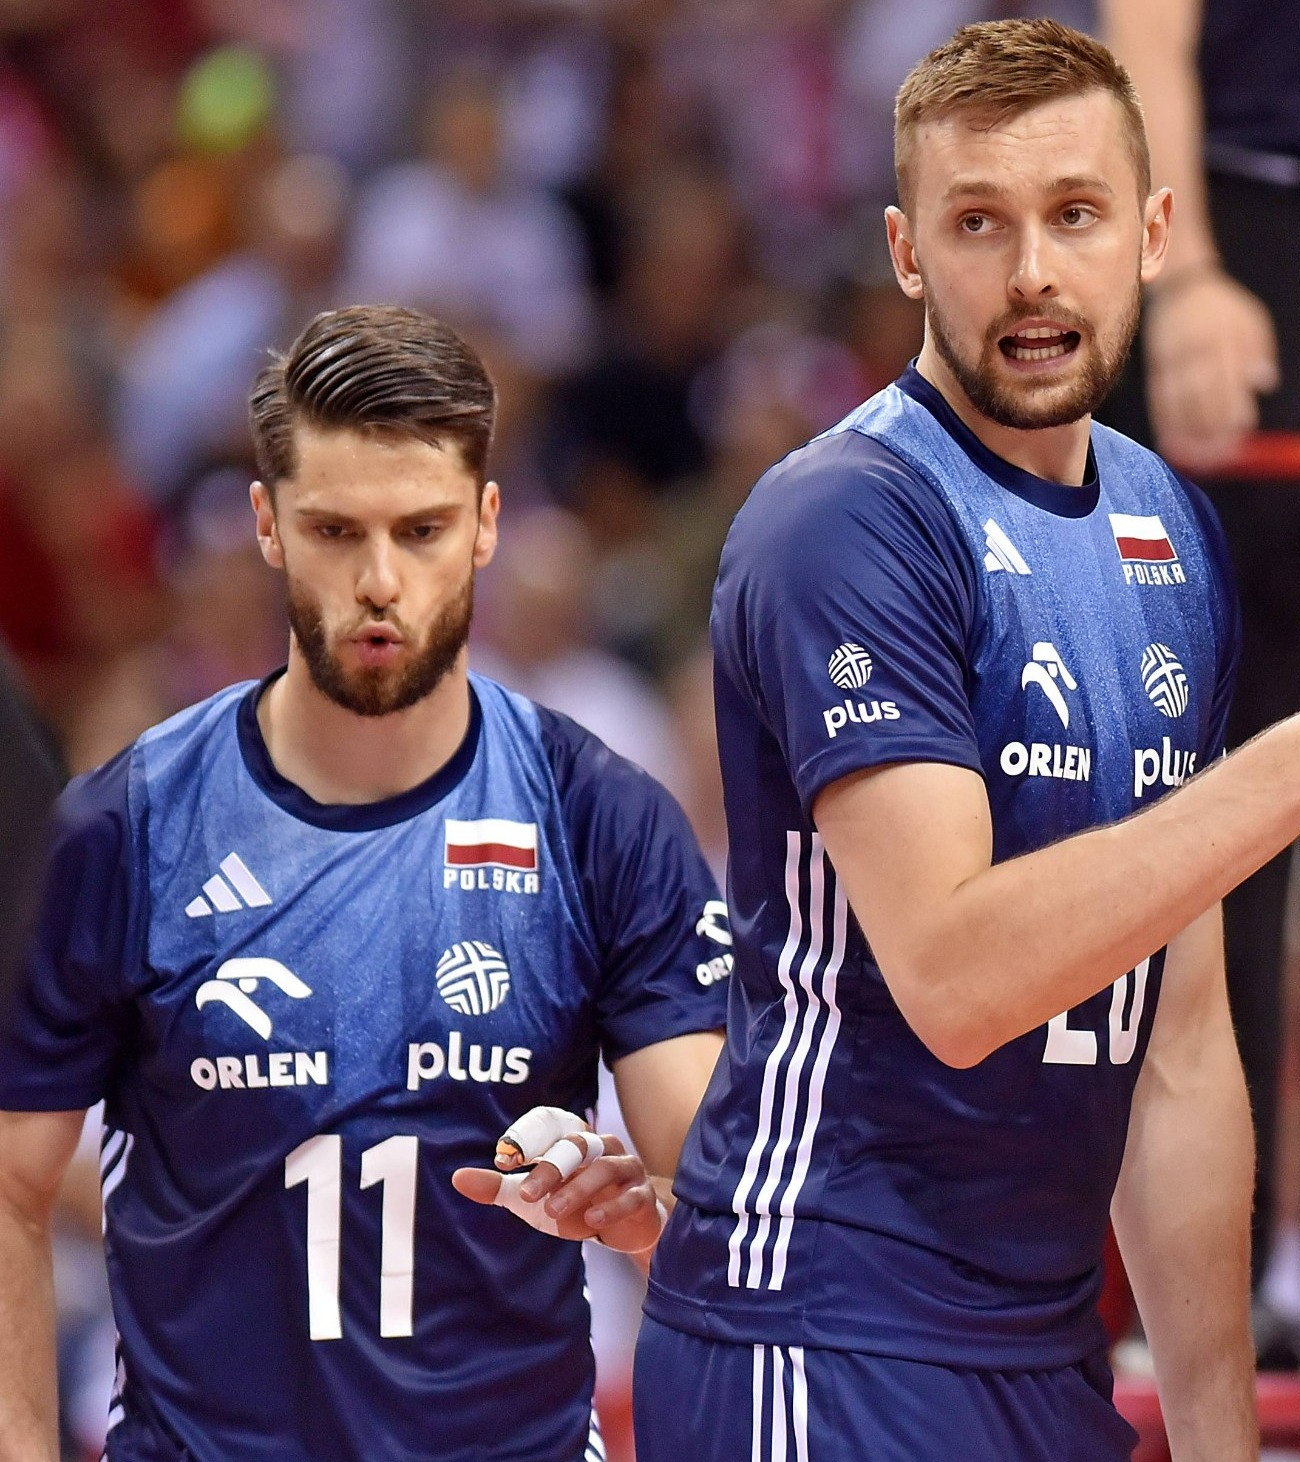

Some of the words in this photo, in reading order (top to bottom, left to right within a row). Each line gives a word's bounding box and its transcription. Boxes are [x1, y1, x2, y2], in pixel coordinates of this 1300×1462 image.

[1122, 563, 1187, 586] POLSKA
[822, 699, 901, 739] plus
[1000, 741, 1091, 782] ORLEN
[443, 868, 539, 894] POLSKA
[190, 1051, 328, 1090] ORLEN
[406, 1031, 532, 1091] plus
[284, 1134, 419, 1341] 11
